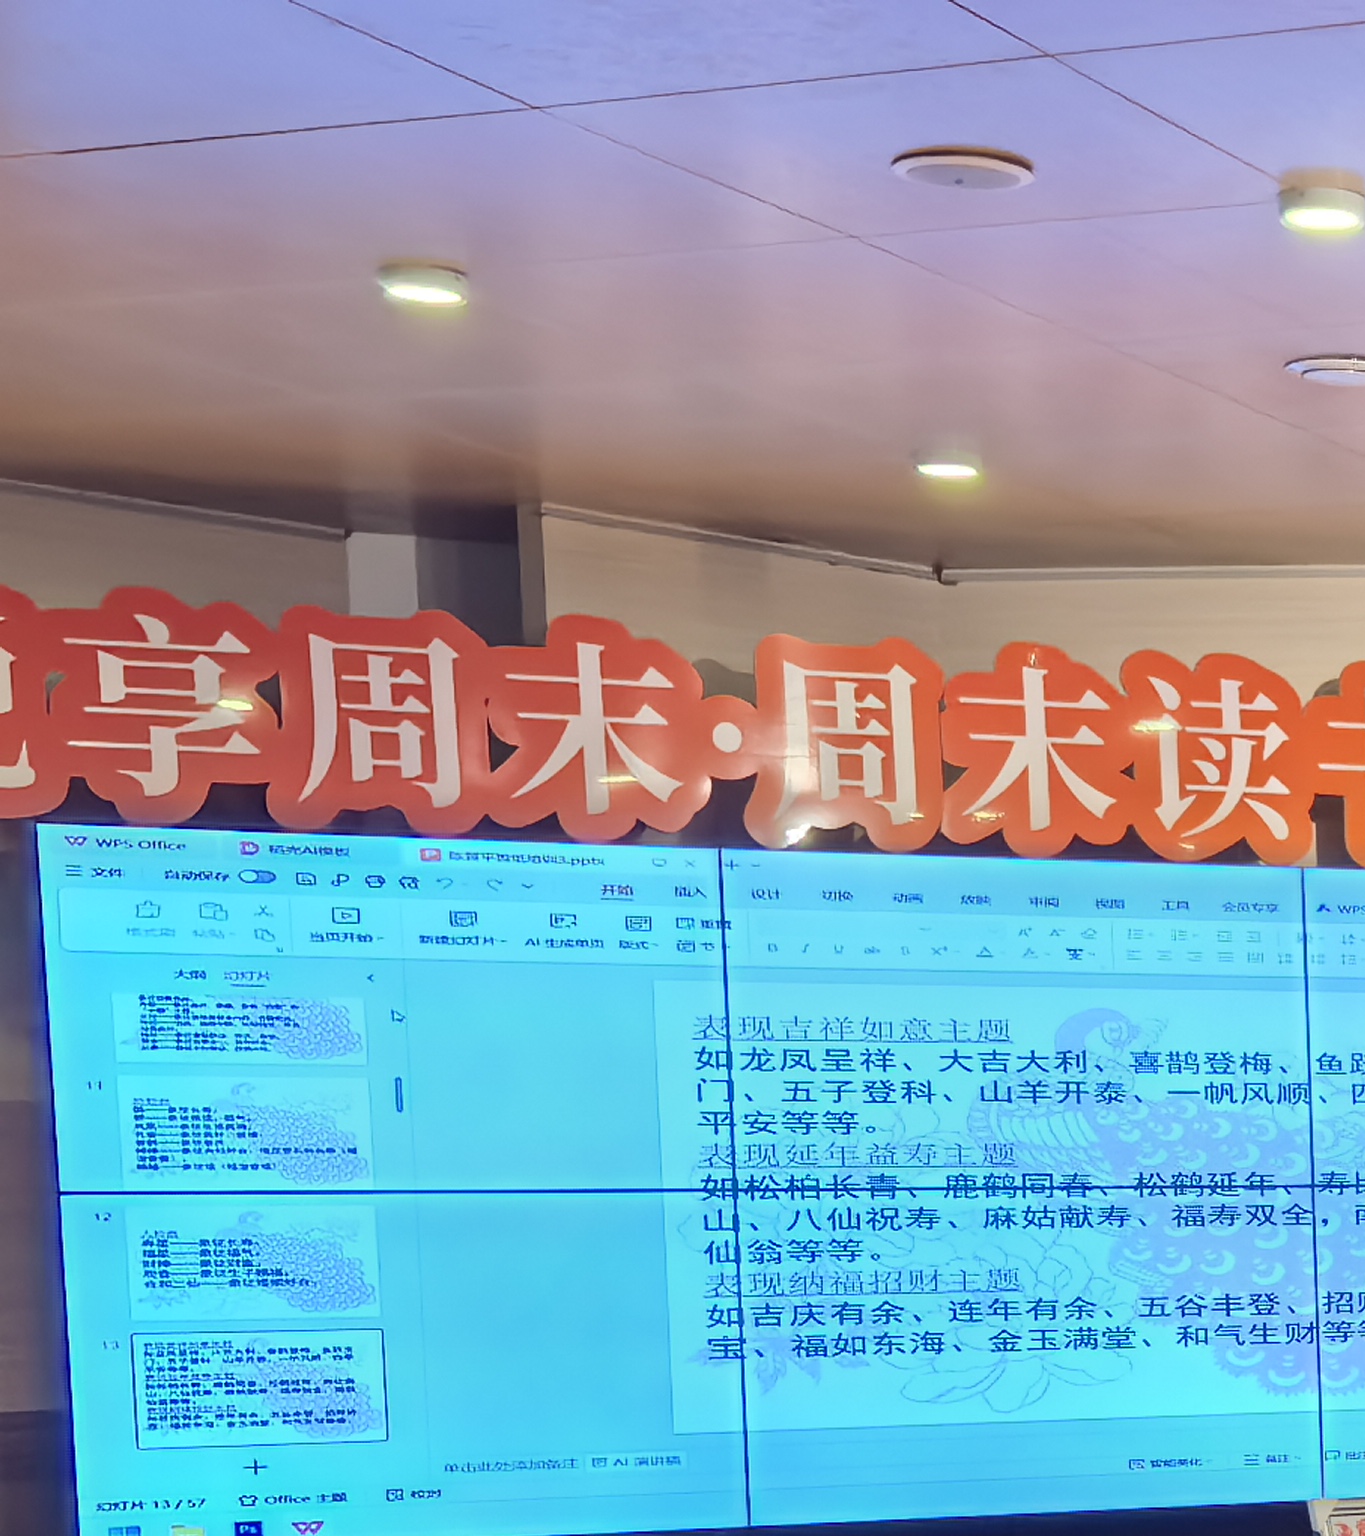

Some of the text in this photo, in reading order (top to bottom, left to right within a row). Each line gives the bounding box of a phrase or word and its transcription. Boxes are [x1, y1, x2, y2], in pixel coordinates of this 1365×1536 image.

[137, 840, 187, 851] Office
[694, 1014, 1012, 1043] 表现吉祥如意主题
[696, 1109, 879, 1136] 平安等等。
[701, 1142, 1018, 1168] 表现延年益寿主题
[703, 1238, 881, 1266] 仙翁等等。
[704, 1267, 1021, 1297] 表现纳福招财主题
[264, 1493, 312, 1505] Office
